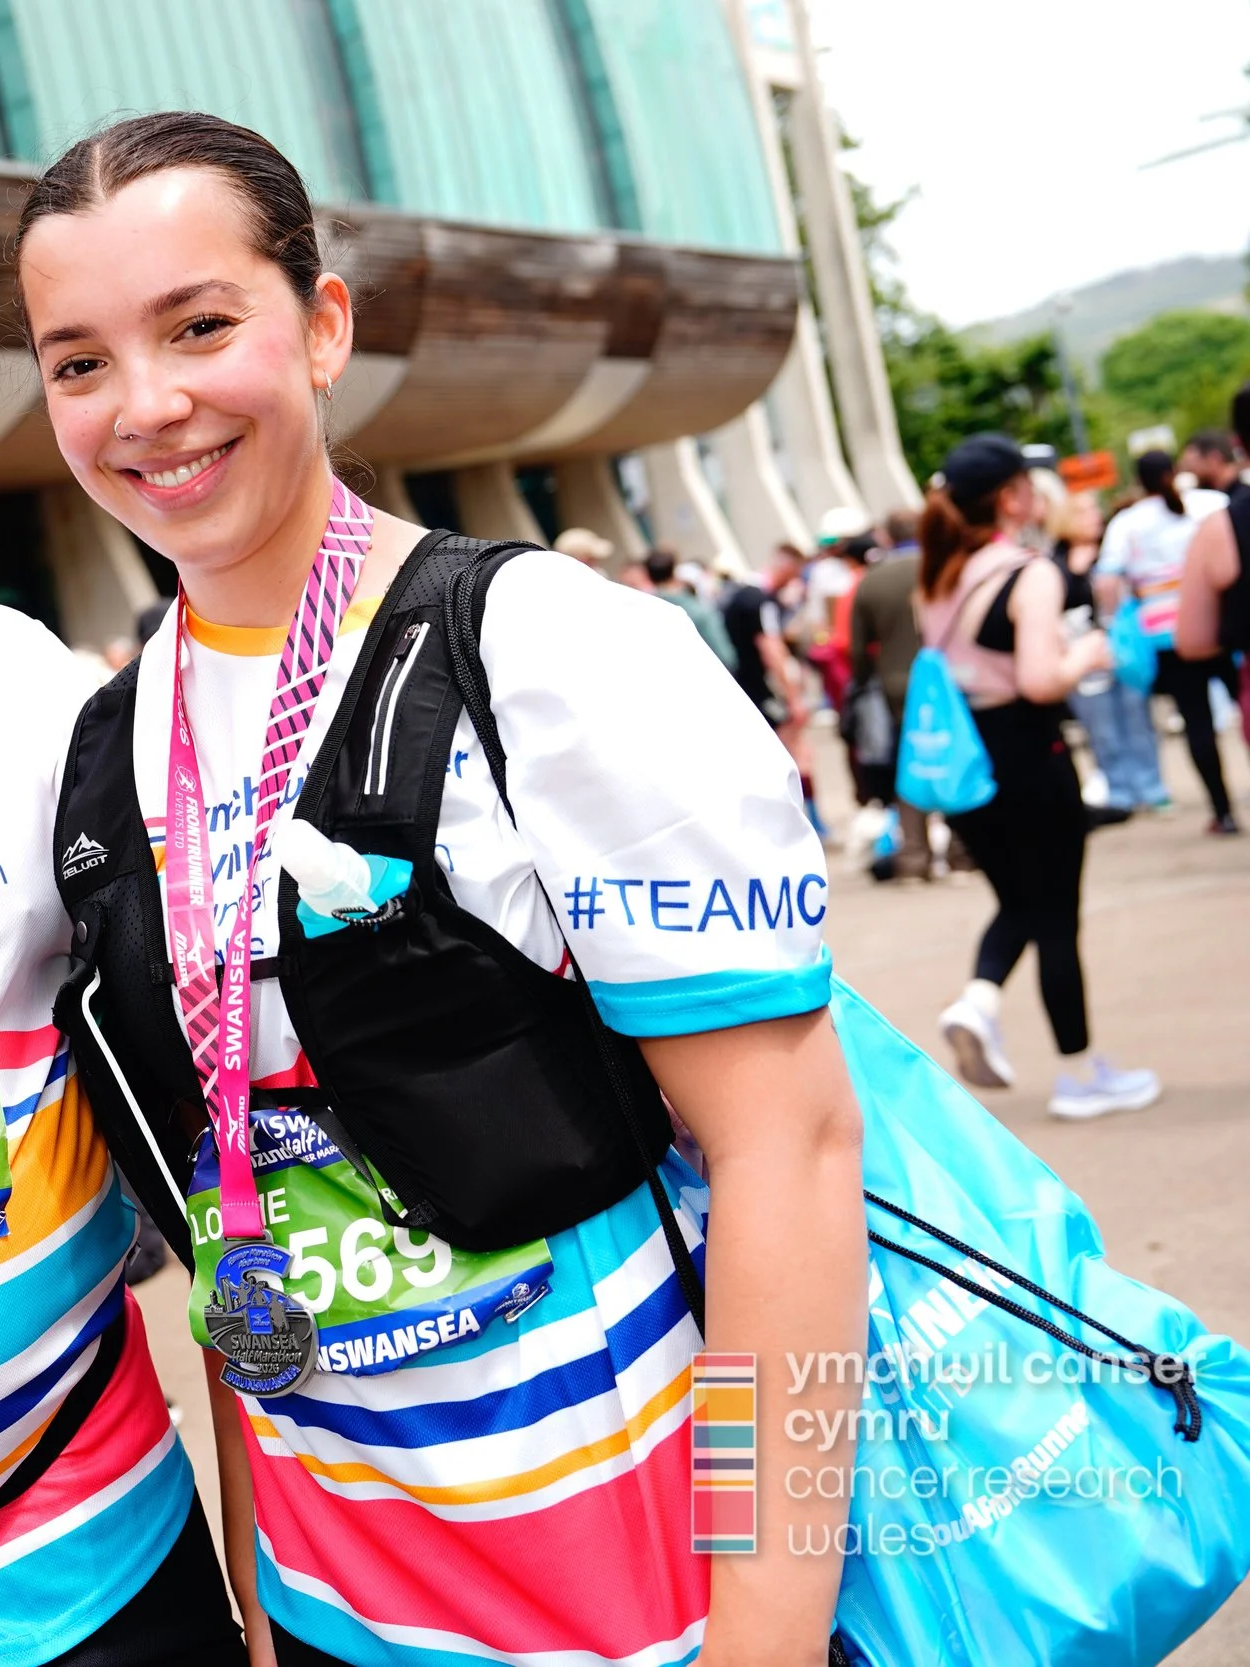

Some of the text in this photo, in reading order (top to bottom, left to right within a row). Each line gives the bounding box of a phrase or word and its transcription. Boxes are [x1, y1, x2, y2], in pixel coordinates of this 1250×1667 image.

[175, 791, 185, 849] EVENTS LTD
[186, 796, 205, 906] FRONTRUNNER
[563, 873, 828, 933] #TEAMC
[224, 928, 246, 1071] SWANSEA
[190, 1187, 290, 1246] LOIE
[275, 1216, 452, 1315] 569
[230, 1333, 300, 1350] SWANSEA
[257, 1362, 280, 1375] 2026
[316, 1307, 481, 1372] NSWANSEA
